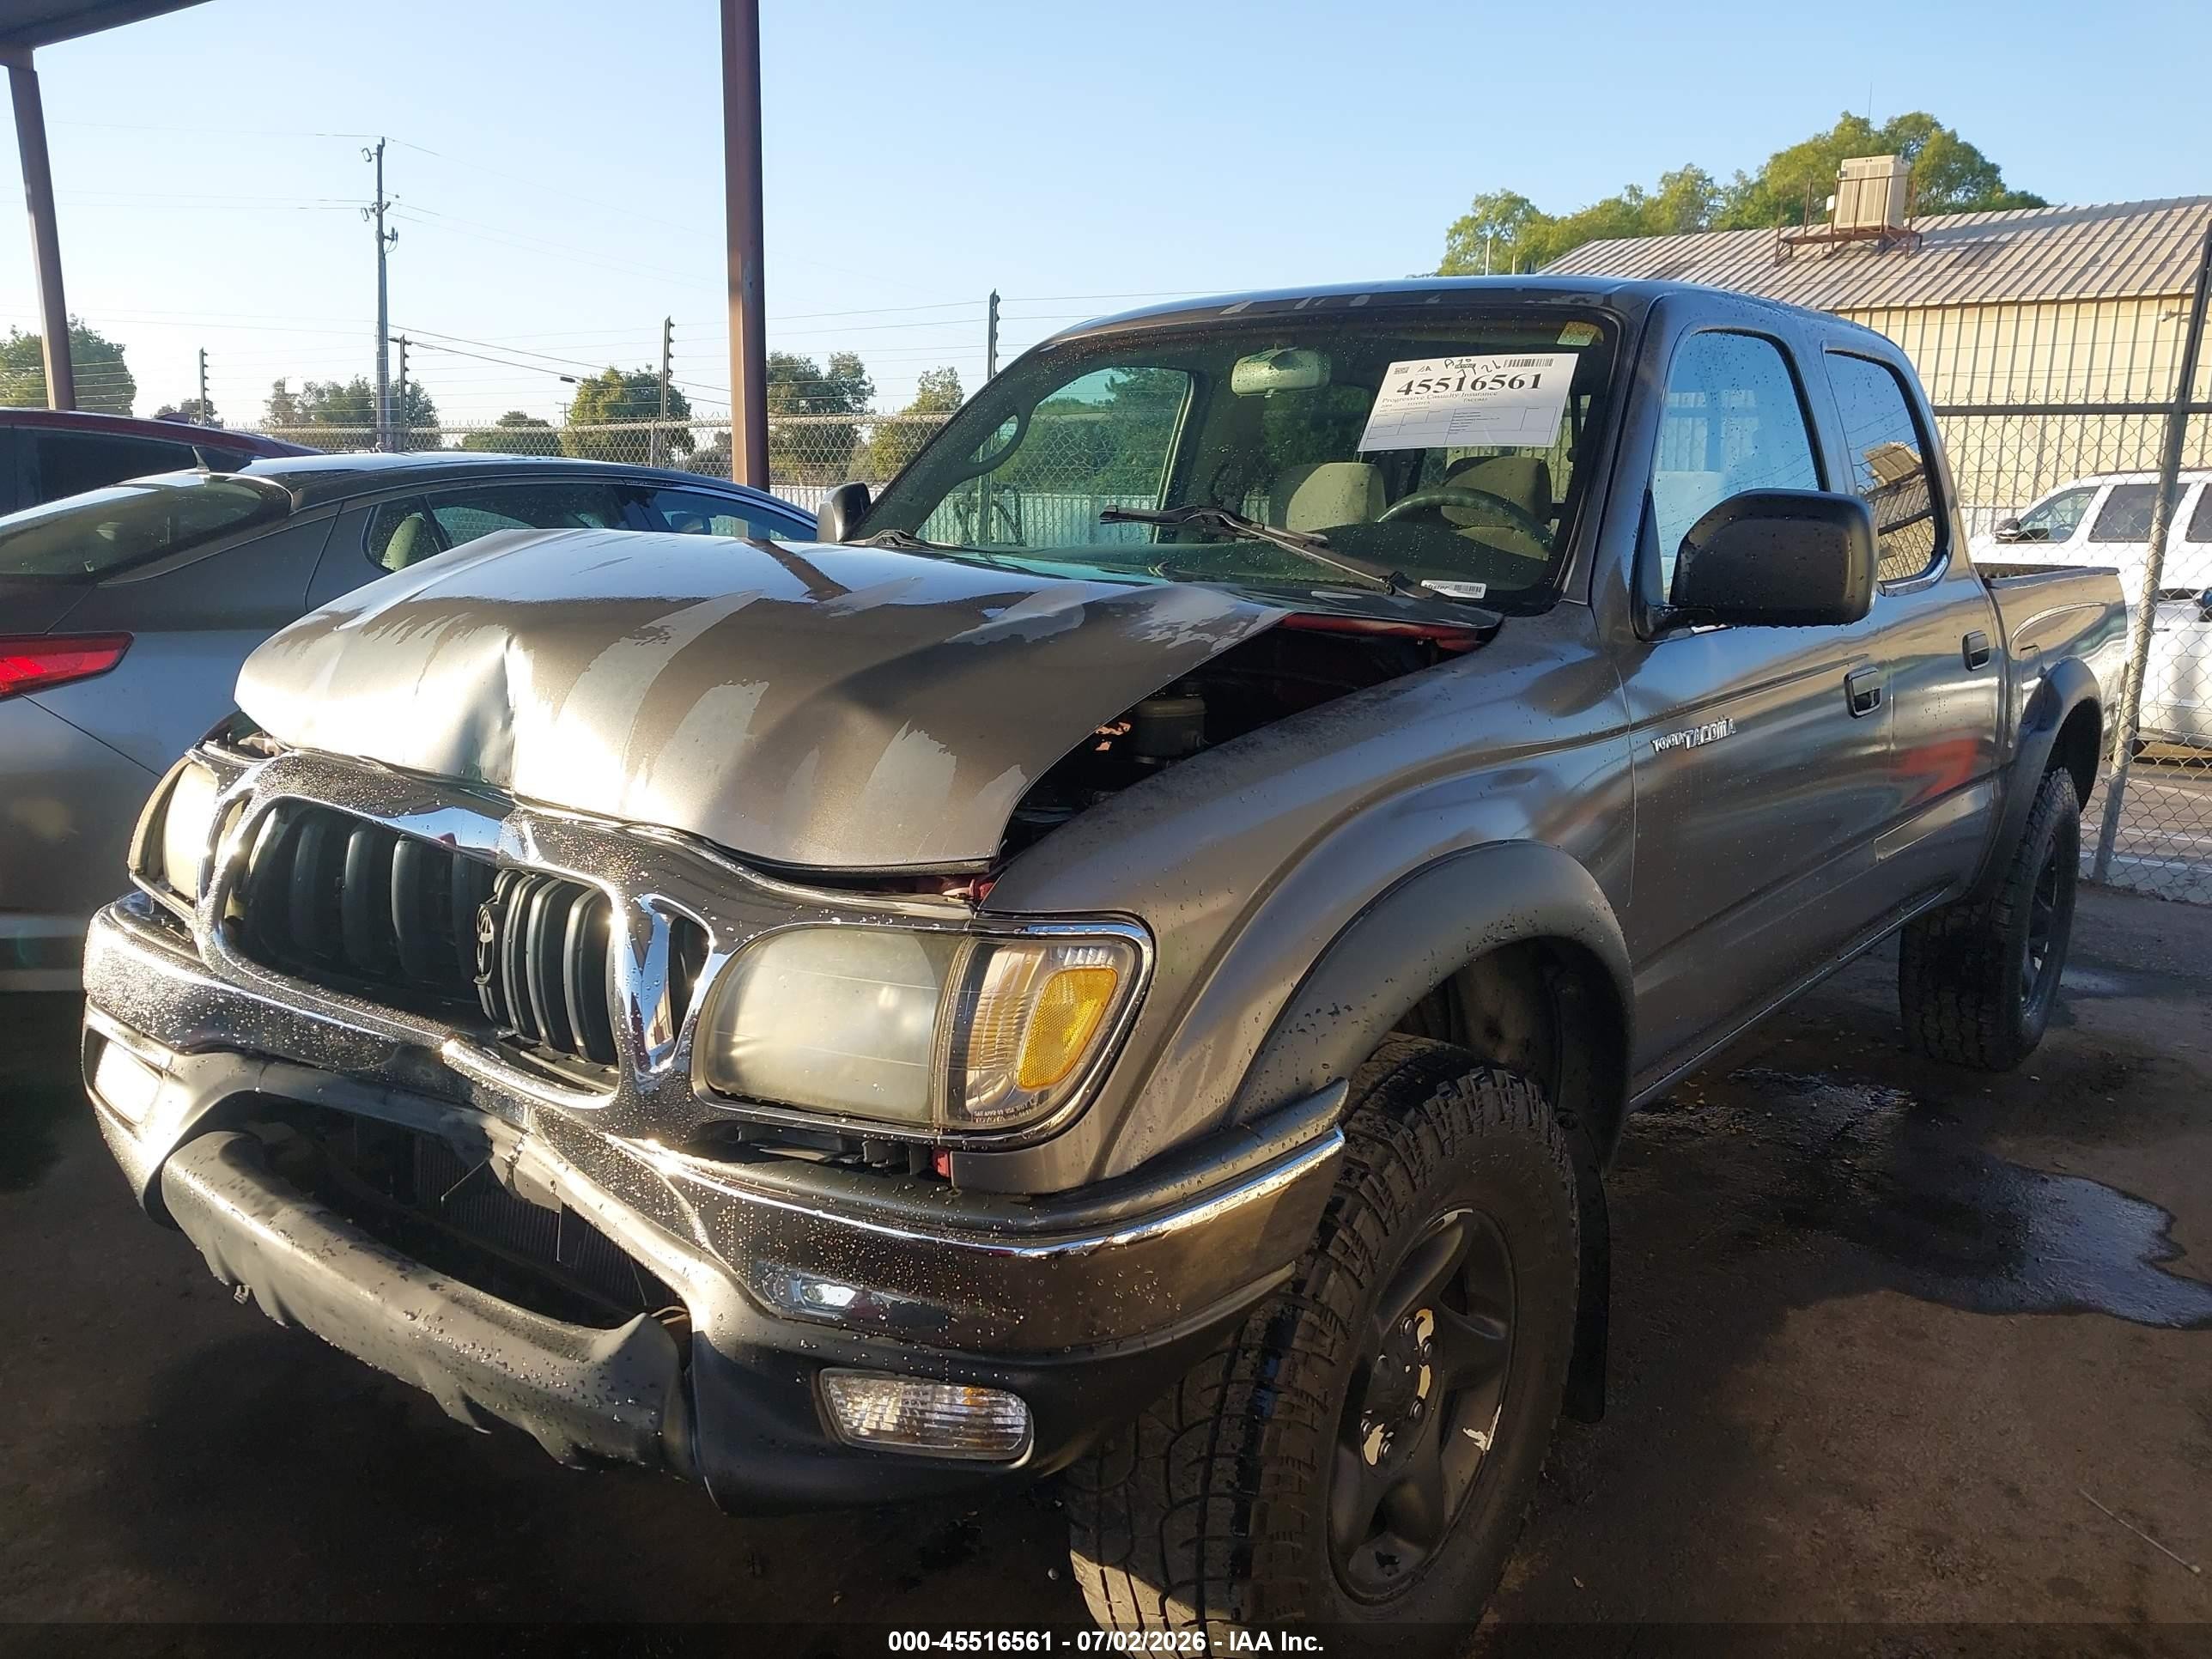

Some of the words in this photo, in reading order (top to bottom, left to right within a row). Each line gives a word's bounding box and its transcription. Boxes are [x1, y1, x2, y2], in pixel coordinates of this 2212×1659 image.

[1396, 373, 1542, 395] 45516561
[1382, 395, 1425, 404] Progressive
[1652, 731, 1684, 752] TOYOTA
[1684, 719, 1736, 750] TACOMA
